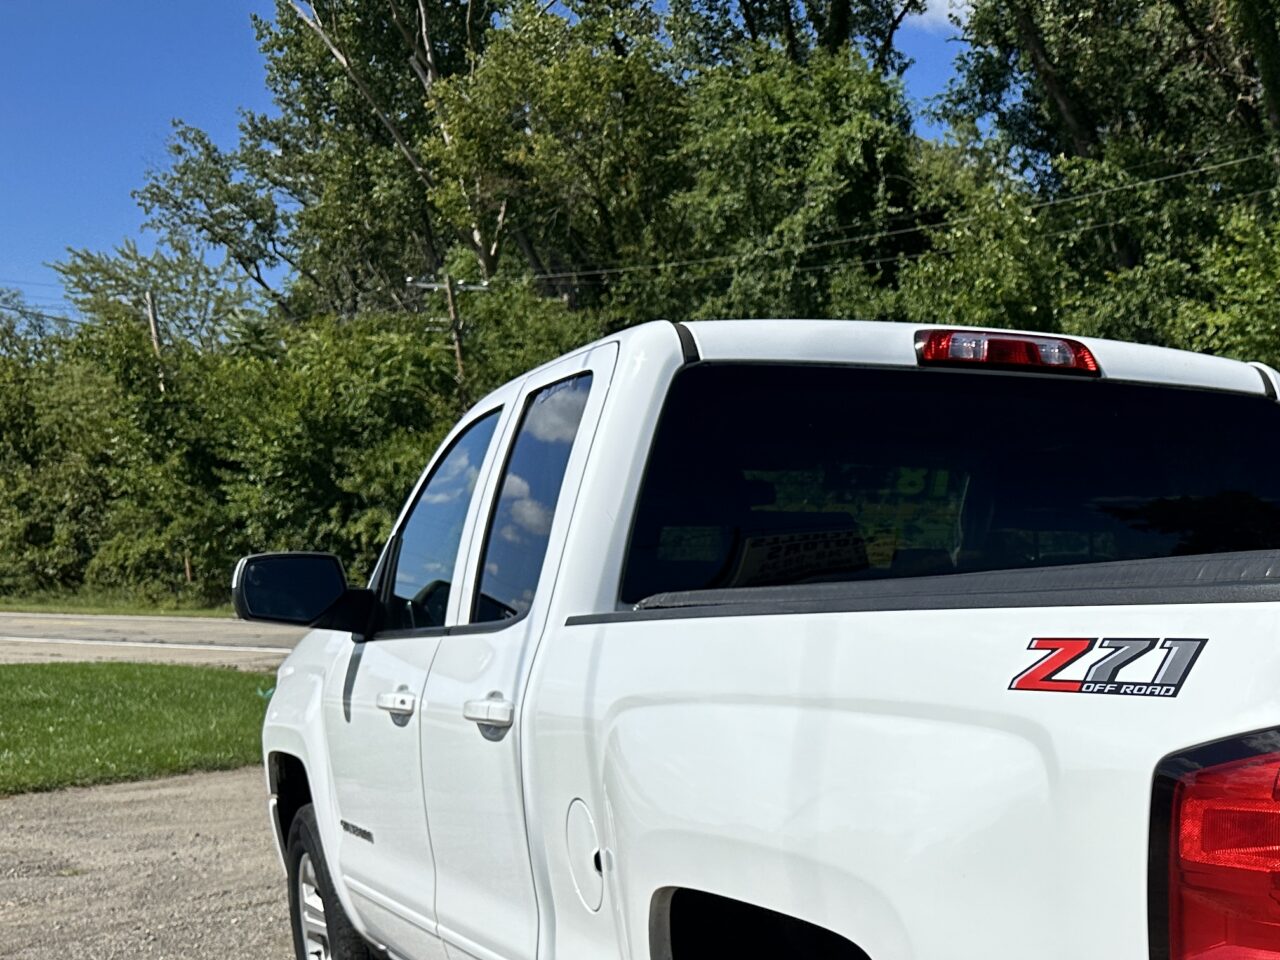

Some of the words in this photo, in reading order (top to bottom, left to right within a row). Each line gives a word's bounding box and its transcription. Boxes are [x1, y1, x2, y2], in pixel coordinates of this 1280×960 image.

[1007, 637, 1209, 693] Z71
[1081, 682, 1117, 694] OFF
[1119, 683, 1176, 697] ROAD
